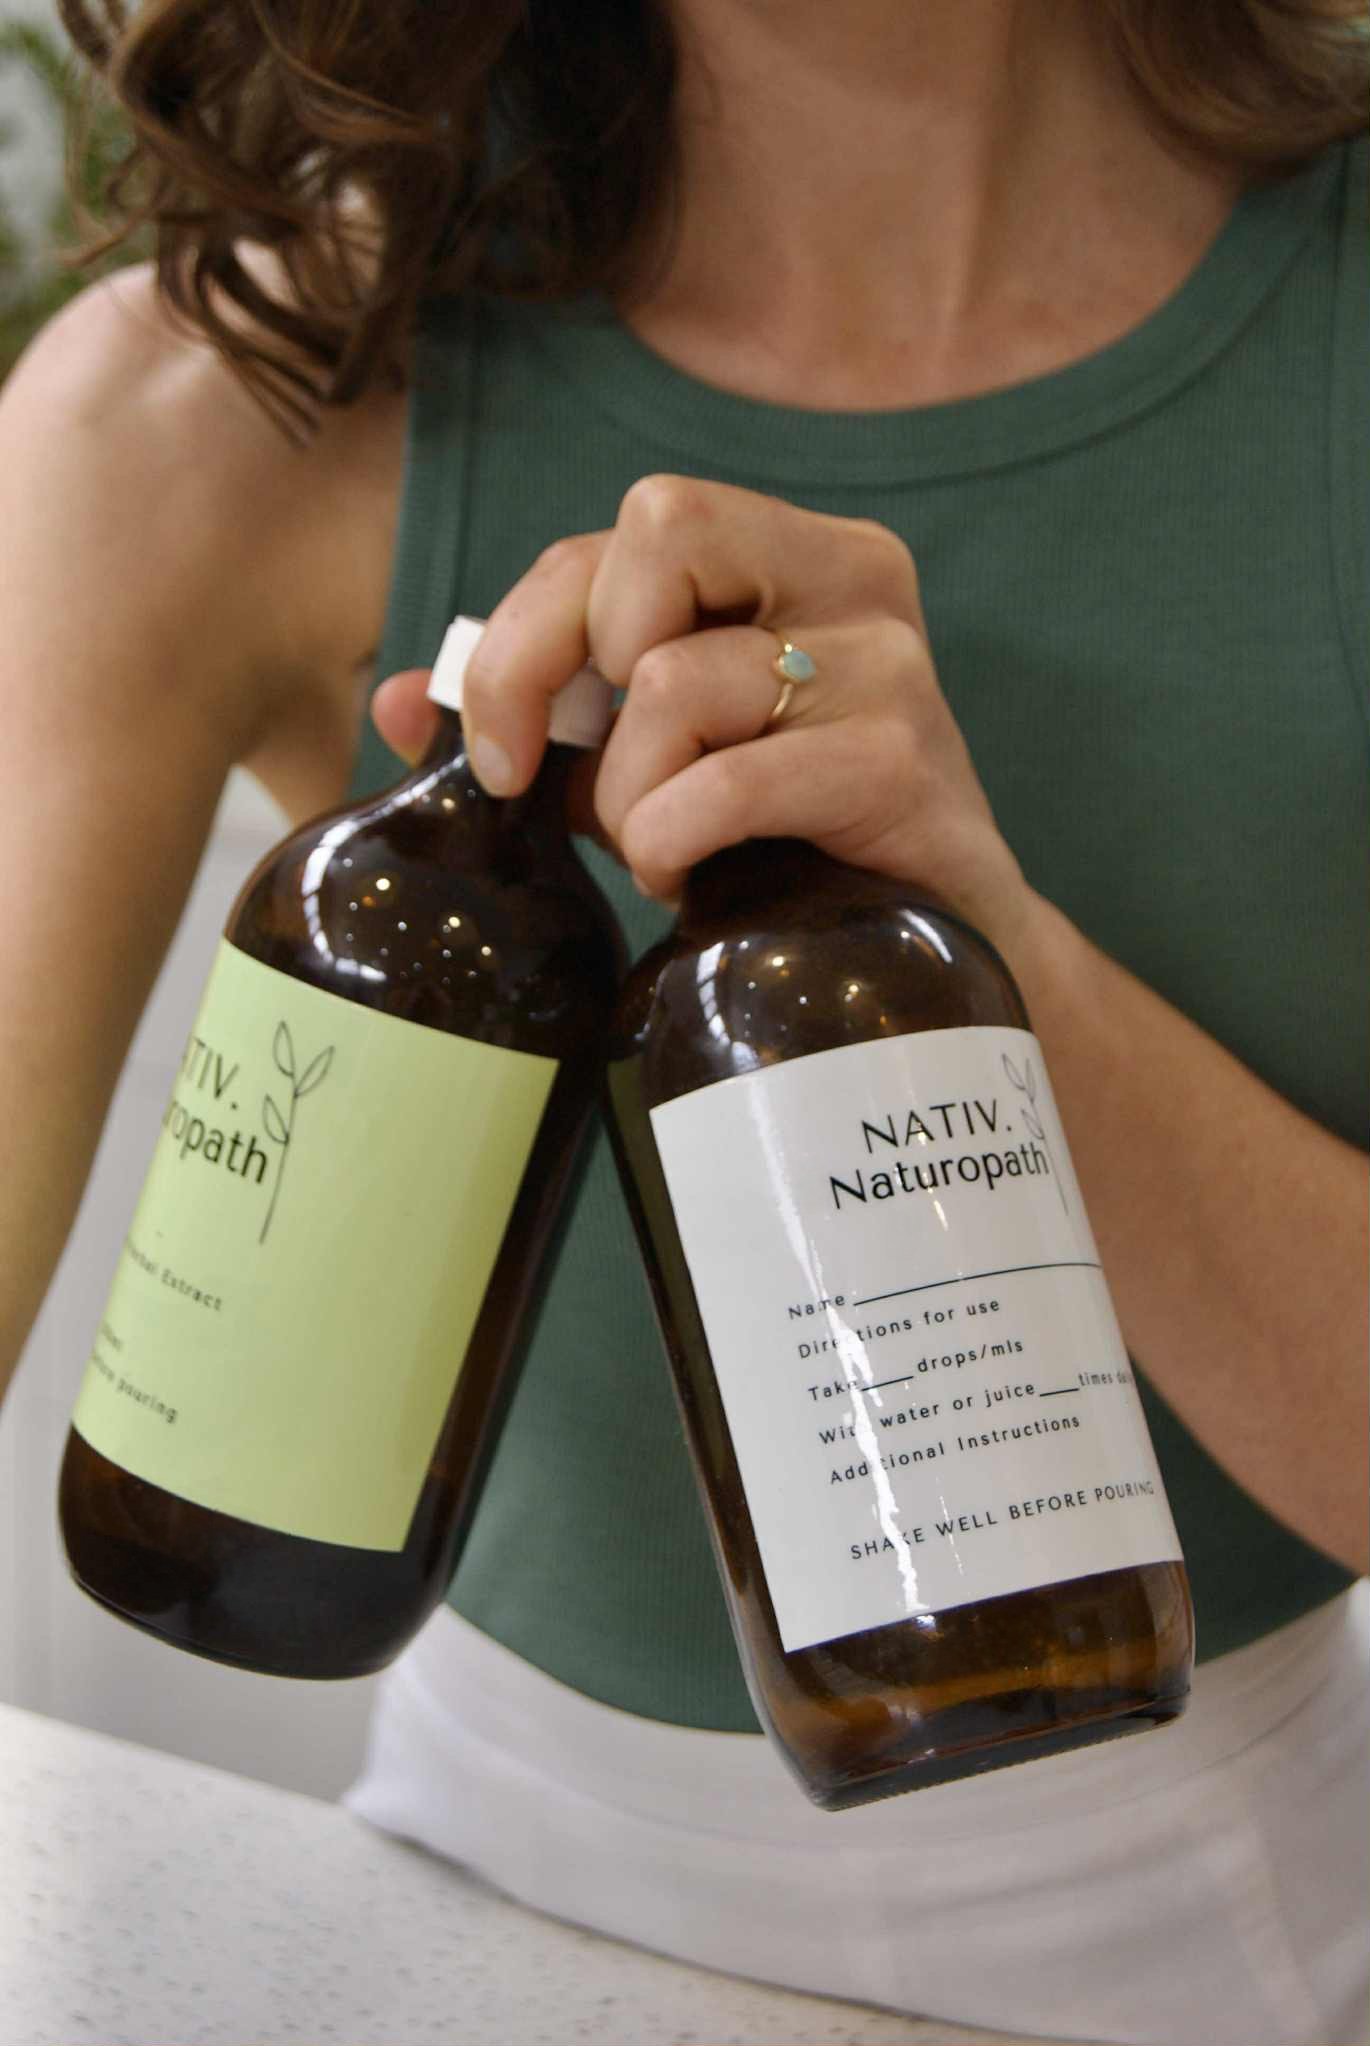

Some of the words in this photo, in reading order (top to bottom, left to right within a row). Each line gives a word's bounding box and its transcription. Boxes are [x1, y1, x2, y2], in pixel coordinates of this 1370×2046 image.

[861, 1098, 1013, 1154] NATIV.
[829, 1142, 1050, 1210] Naturopath
[797, 1317, 913, 1360] Dirtions
[923, 1306, 955, 1326] for
[966, 1298, 1001, 1317] use
[916, 1339, 1024, 1374] drops/mls
[818, 1424, 864, 1444] Wit
[879, 1402, 940, 1429] water
[952, 1395, 974, 1412] or
[984, 1382, 1036, 1409] juice
[1078, 1370, 1114, 1387] times
[830, 1440, 945, 1485] Addional
[957, 1414, 1081, 1451] Instructions
[935, 1510, 999, 1538] WELL
[1008, 1489, 1088, 1521] BEFORE
[1094, 1480, 1156, 1504] POURING
